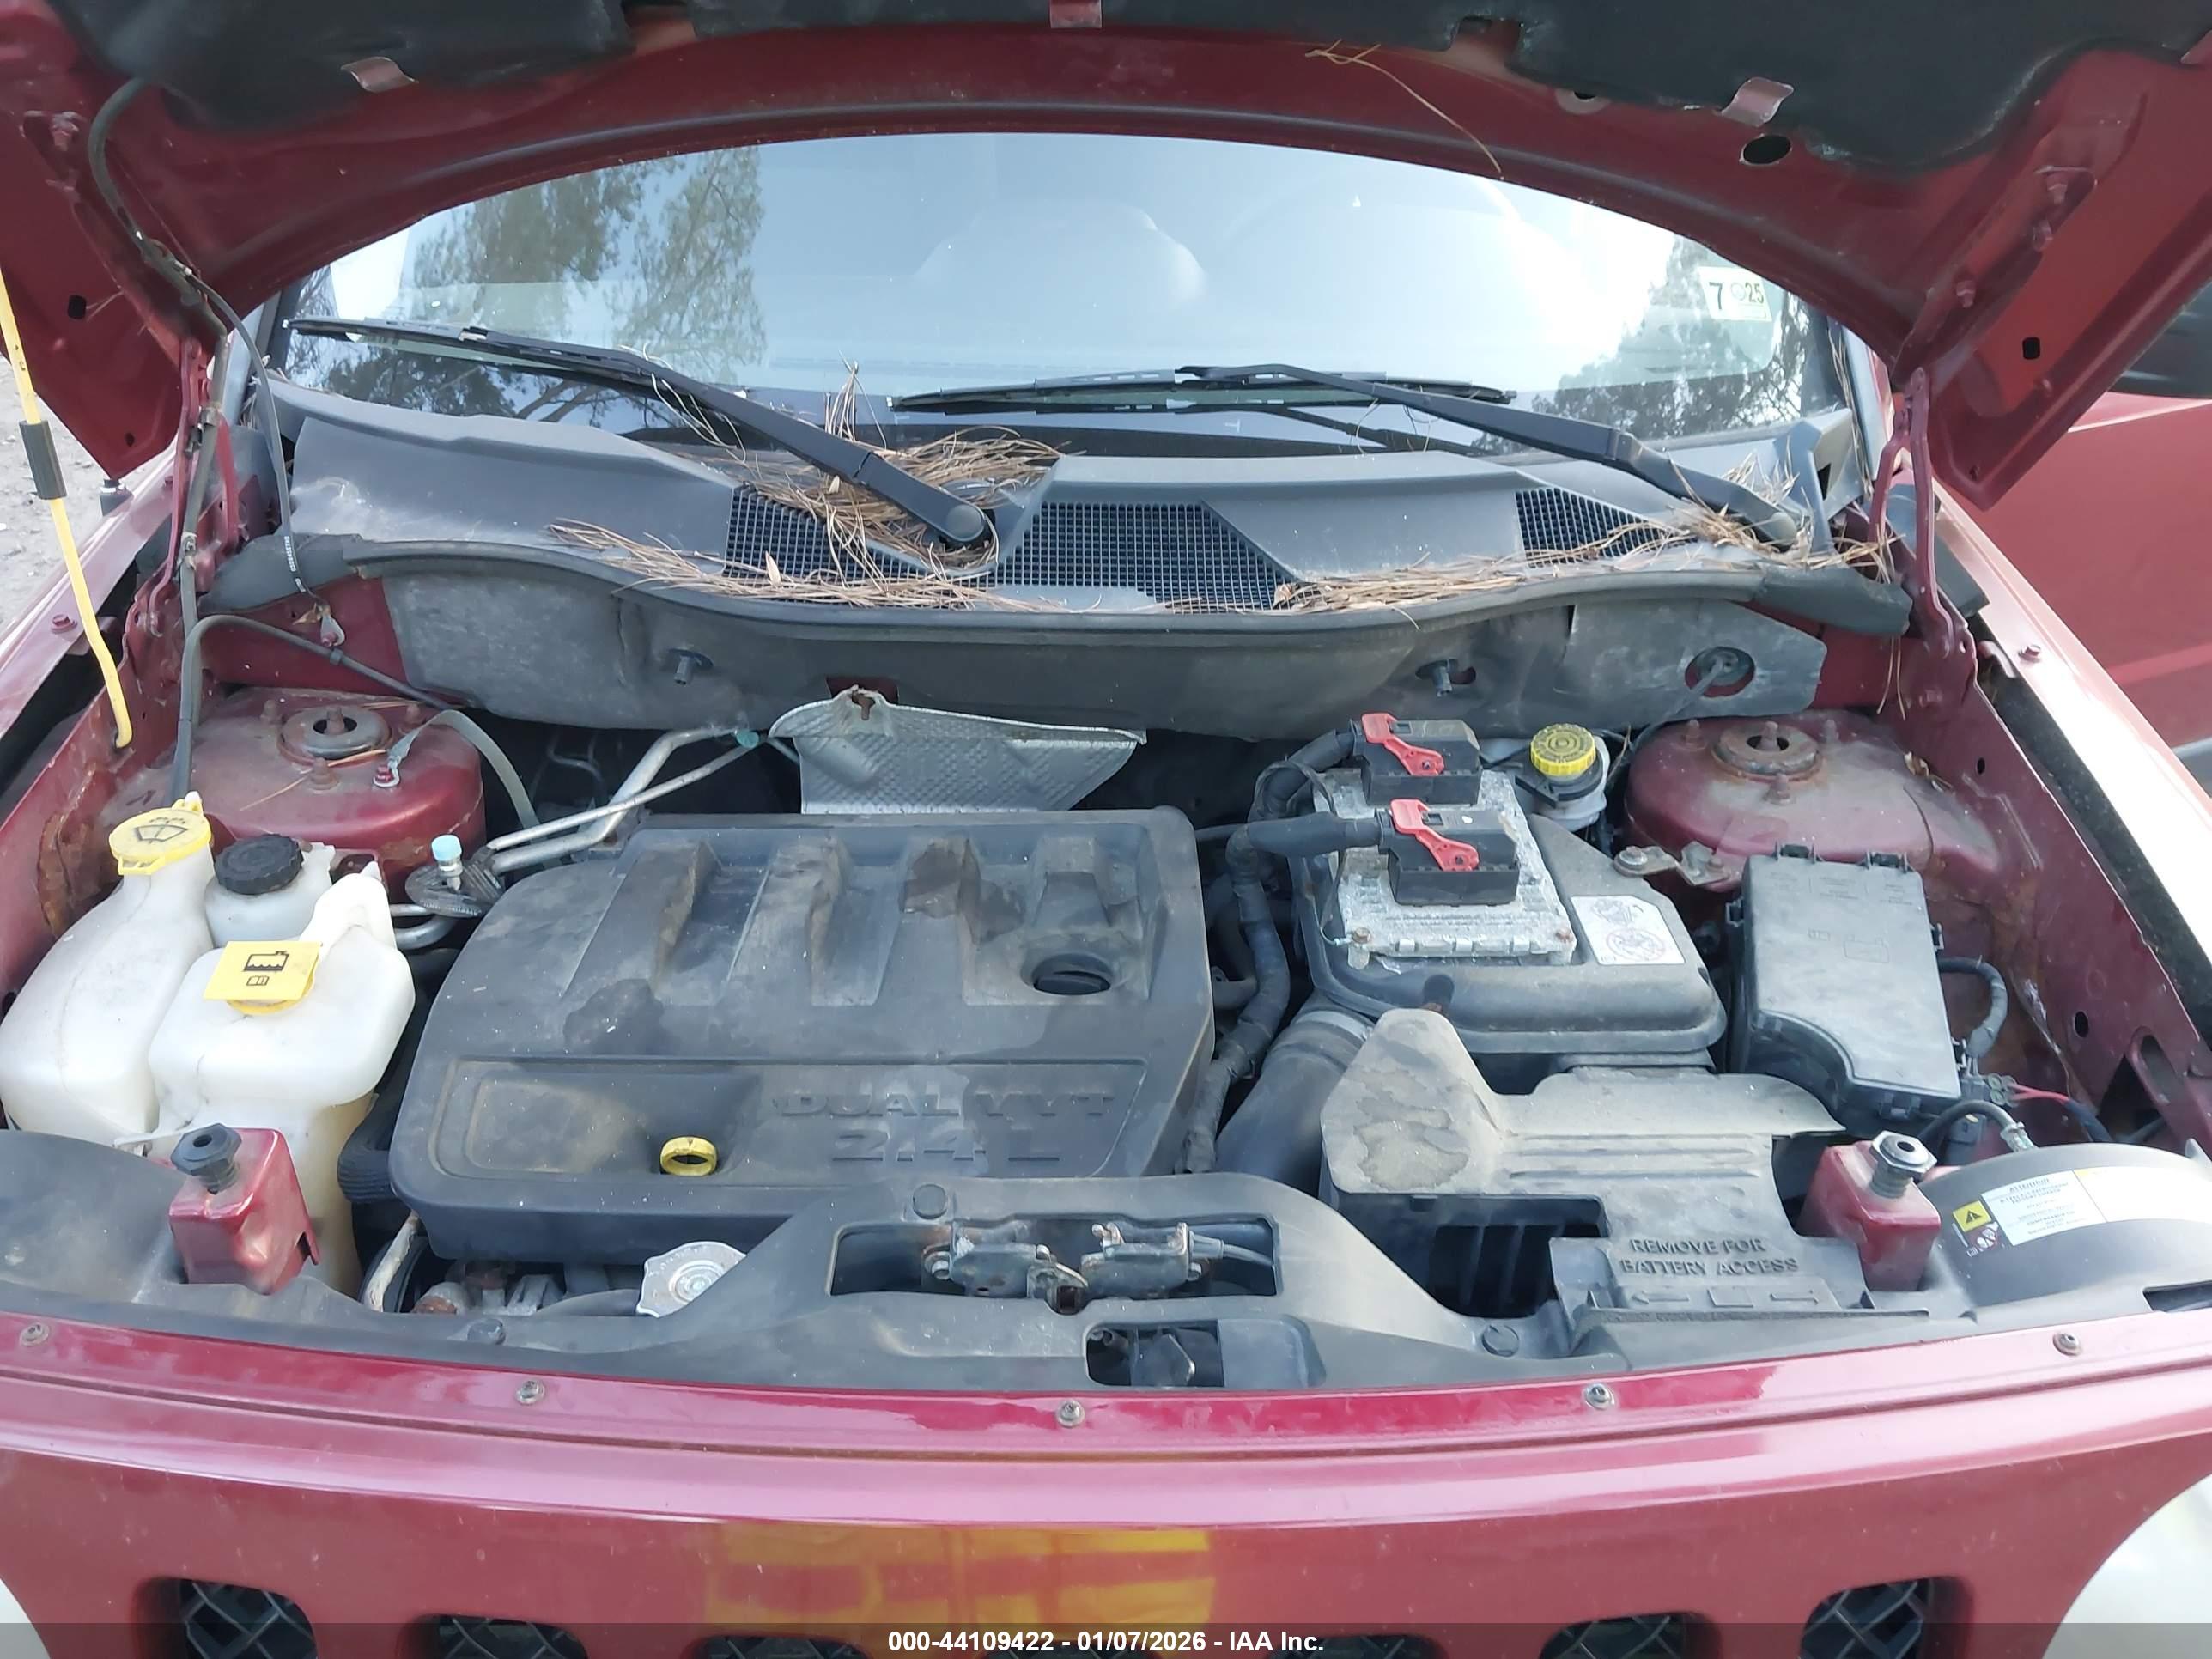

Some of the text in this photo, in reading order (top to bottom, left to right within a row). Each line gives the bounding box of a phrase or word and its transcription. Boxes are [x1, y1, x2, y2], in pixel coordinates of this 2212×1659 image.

[1709, 281, 1765, 310] 7 25
[781, 1092, 1115, 1117] DUAL VVT
[1630, 1237, 1766, 1255] REMOVE FOR
[1620, 1257, 1799, 1276] BATTERY ACCESS
